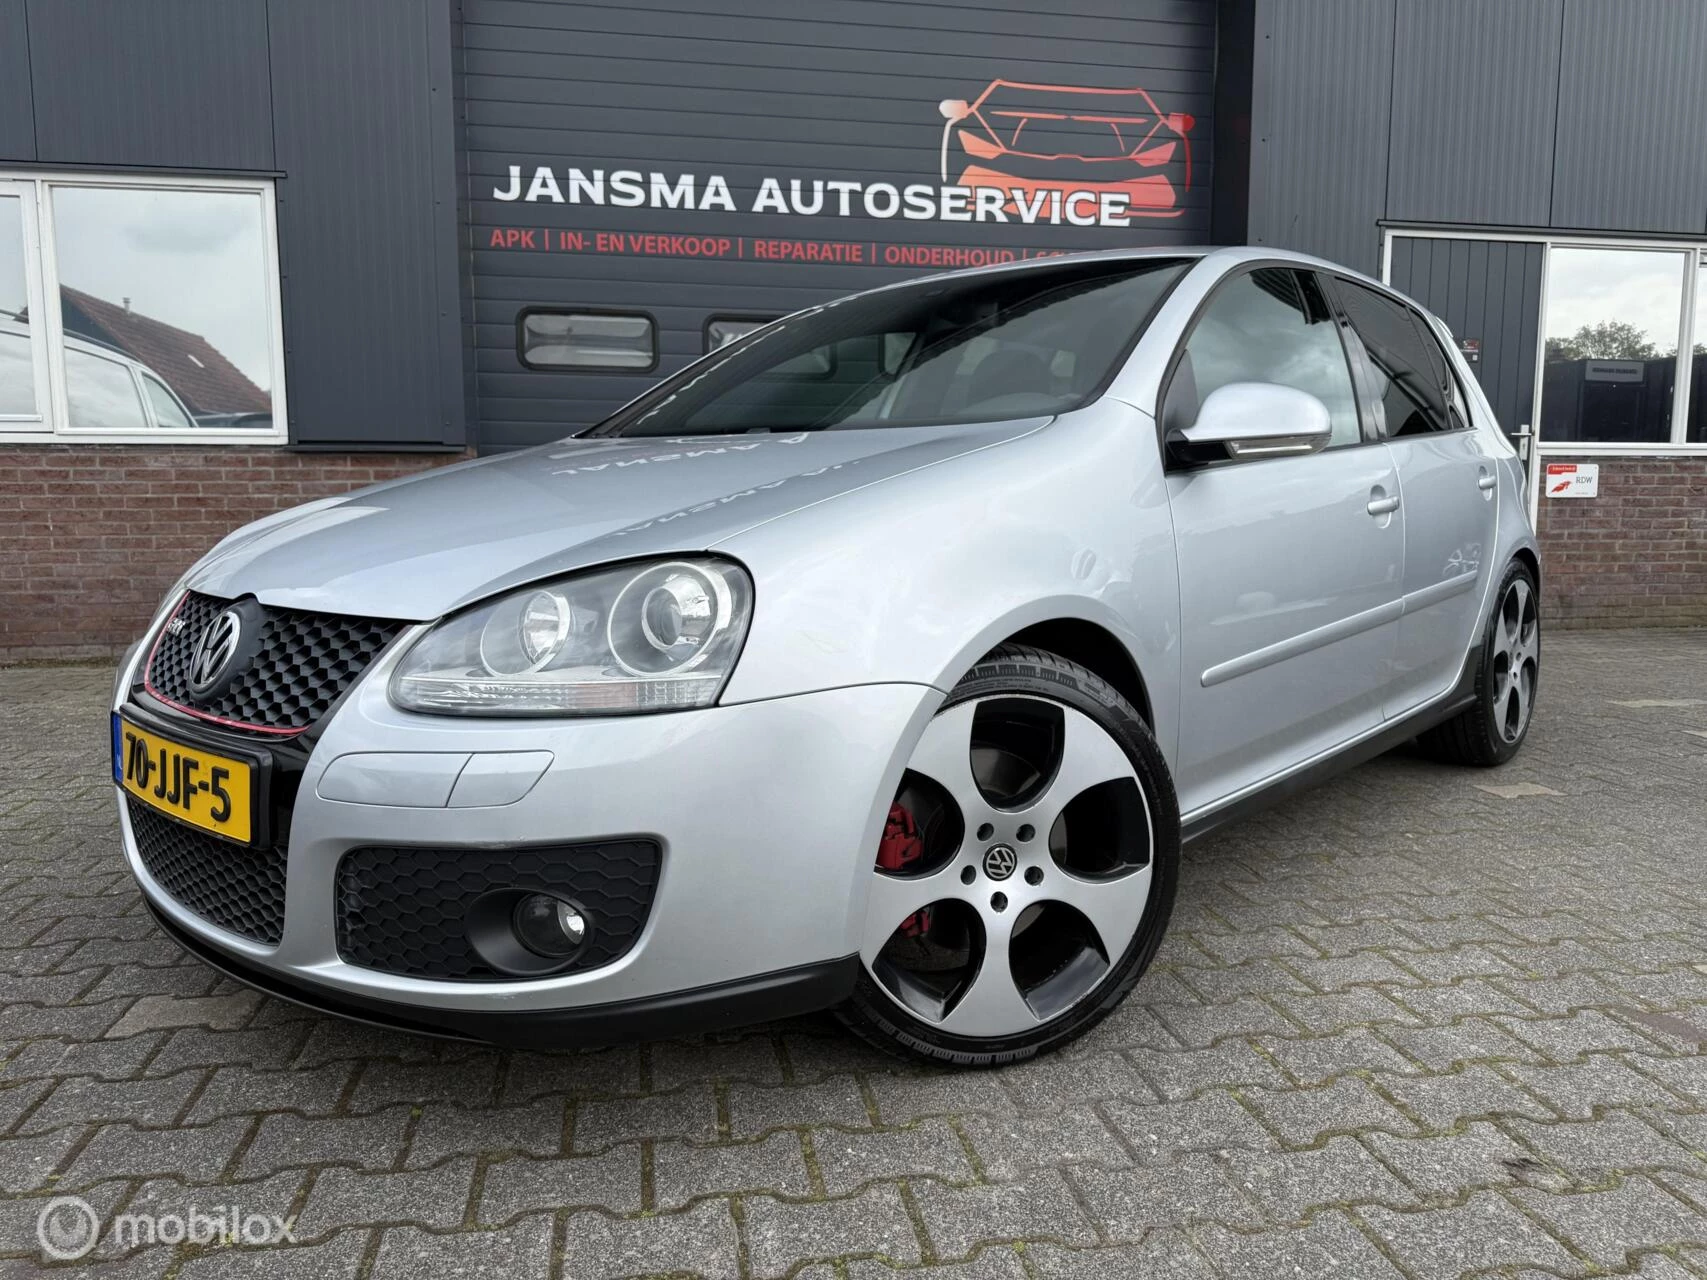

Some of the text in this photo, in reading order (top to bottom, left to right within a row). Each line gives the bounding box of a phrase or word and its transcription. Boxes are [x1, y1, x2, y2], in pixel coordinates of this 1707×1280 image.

[493, 165, 1131, 227] JANSMA AUTOSERVICE
[490, 228, 536, 250] APK
[560, 231, 590, 250] IN-
[597, 234, 625, 252] EN
[629, 235, 731, 257] VERKOOP
[754, 239, 862, 262] REPARATIE
[884, 246, 1014, 267] ONDERHOUD
[1576, 476, 1592, 484] RDW
[126, 732, 231, 822] 70-JJF-5
